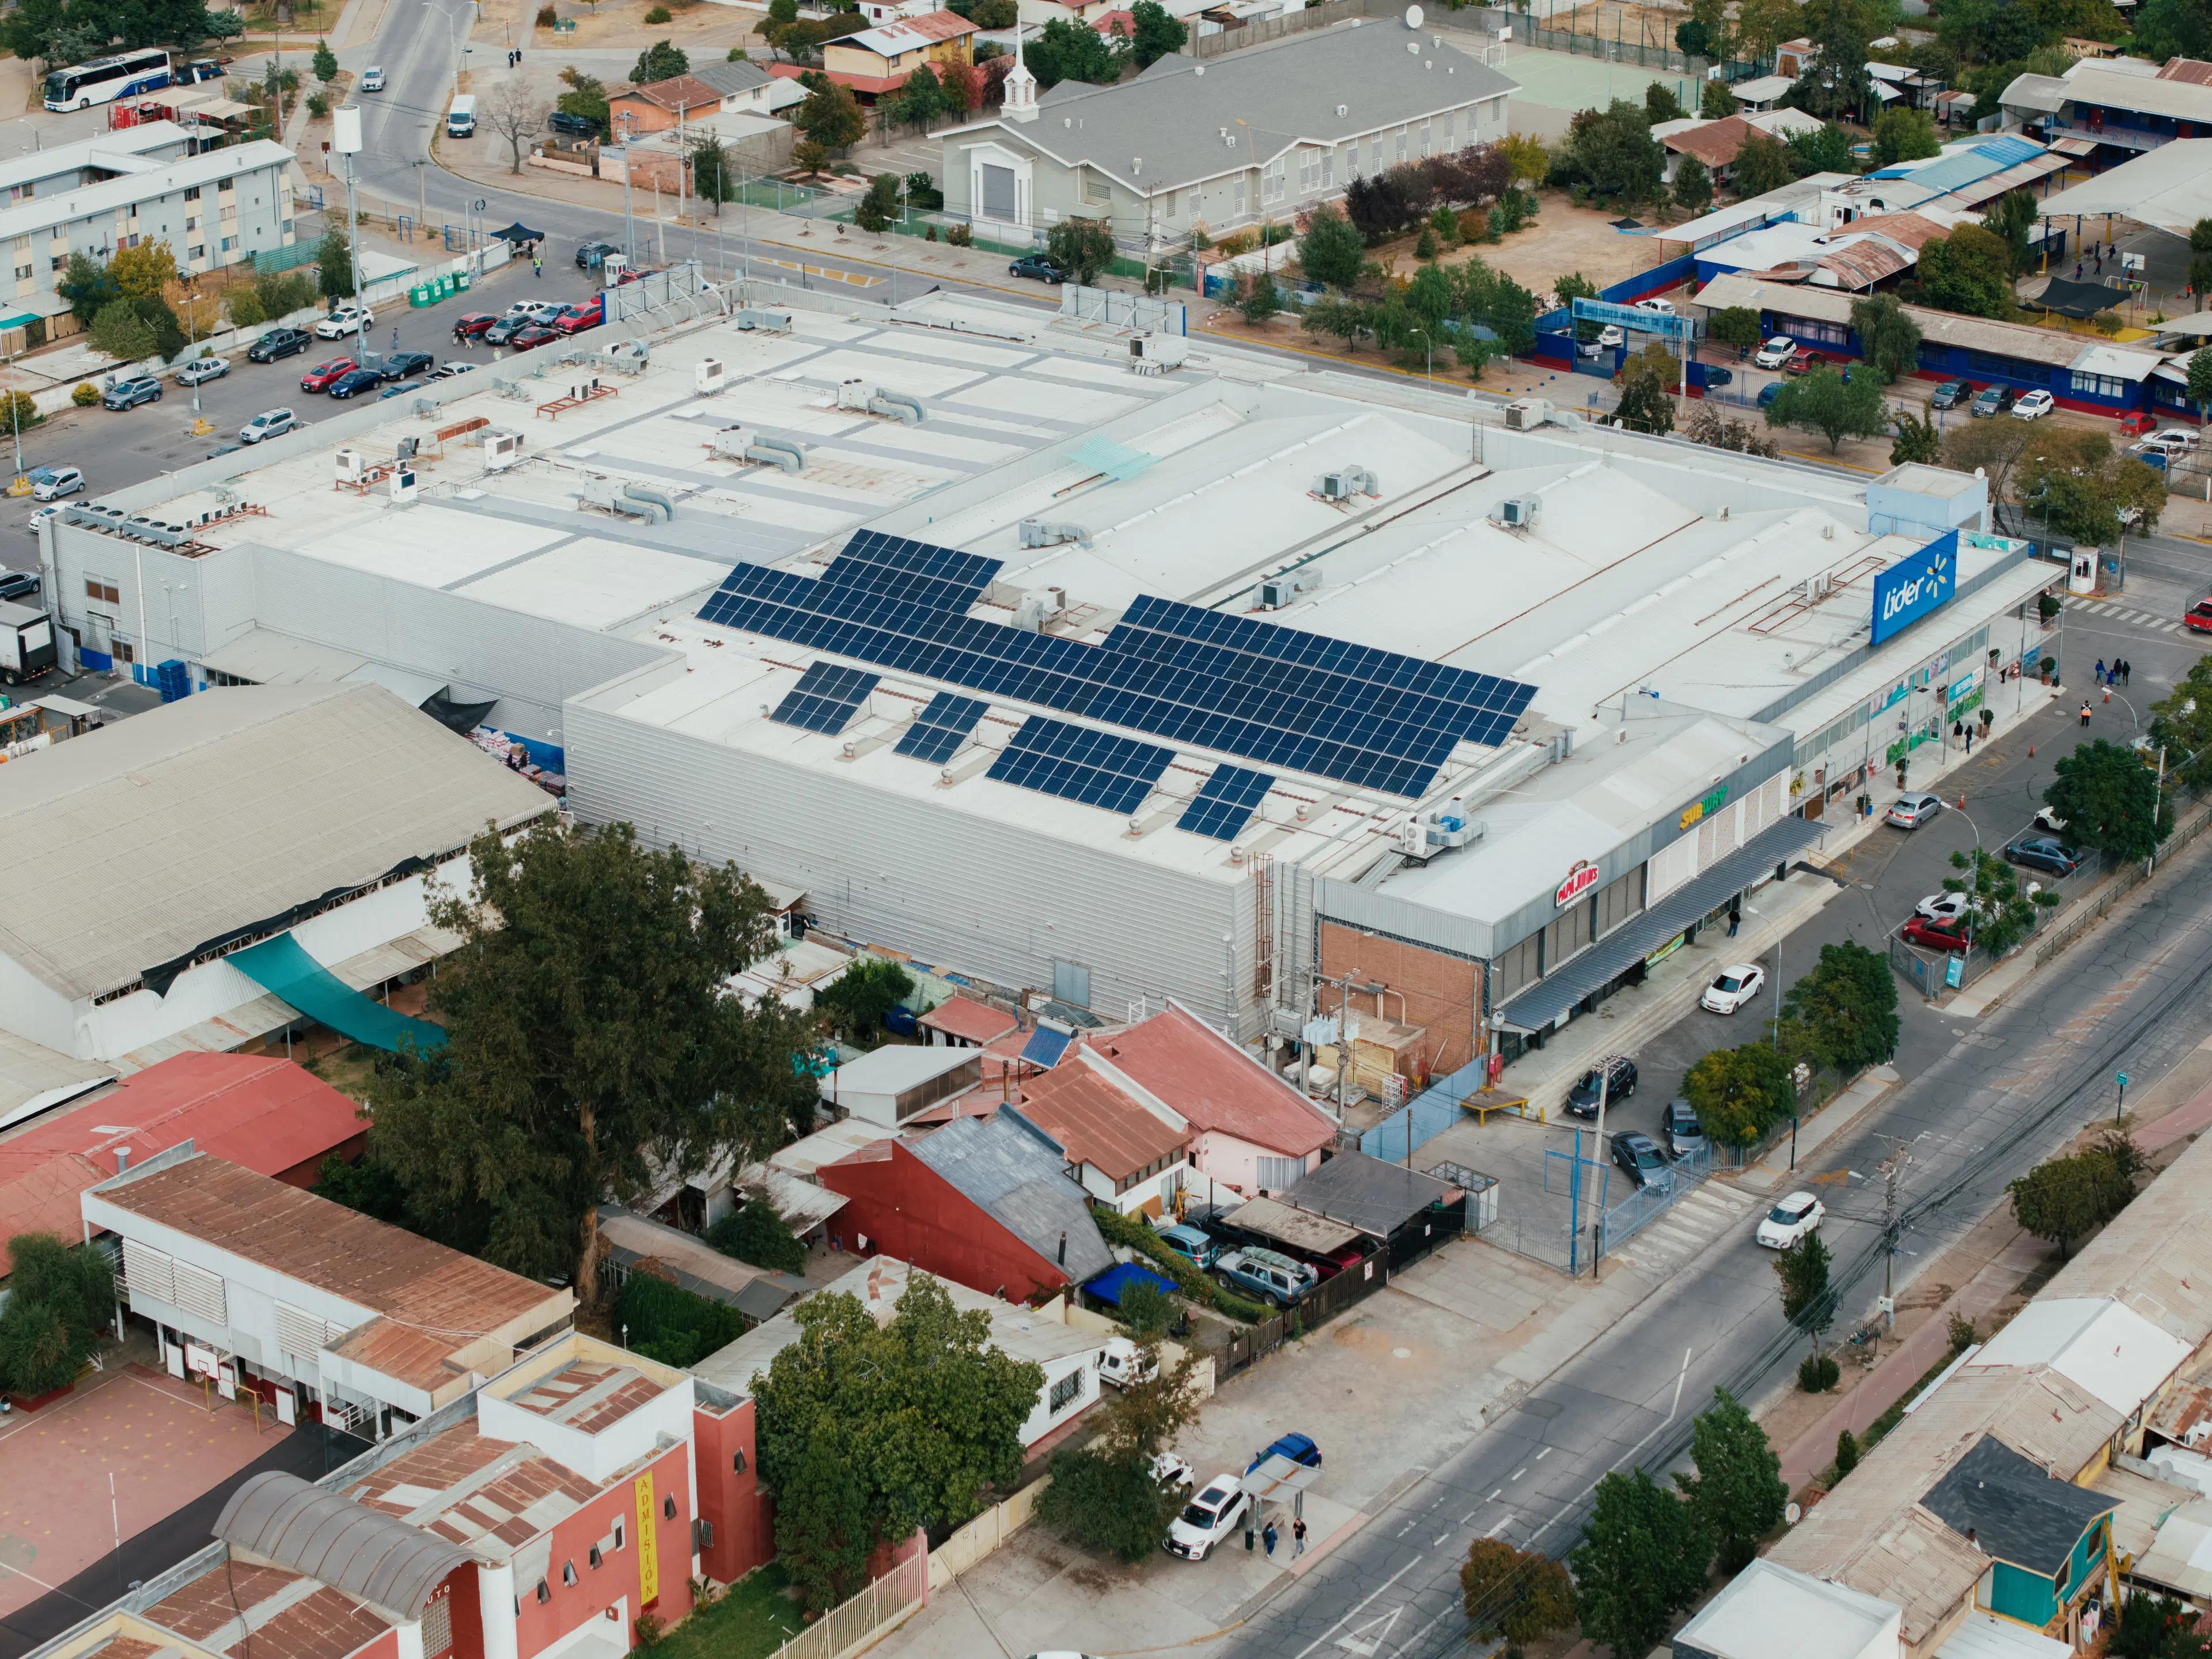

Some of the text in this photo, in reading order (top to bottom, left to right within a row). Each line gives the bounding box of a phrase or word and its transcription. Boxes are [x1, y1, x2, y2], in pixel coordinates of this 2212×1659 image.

[1680, 786, 1728, 830] SUBWAY
[1558, 878, 1574, 903] PAPA
[640, 1479, 653, 1597] ADMISIÓN
